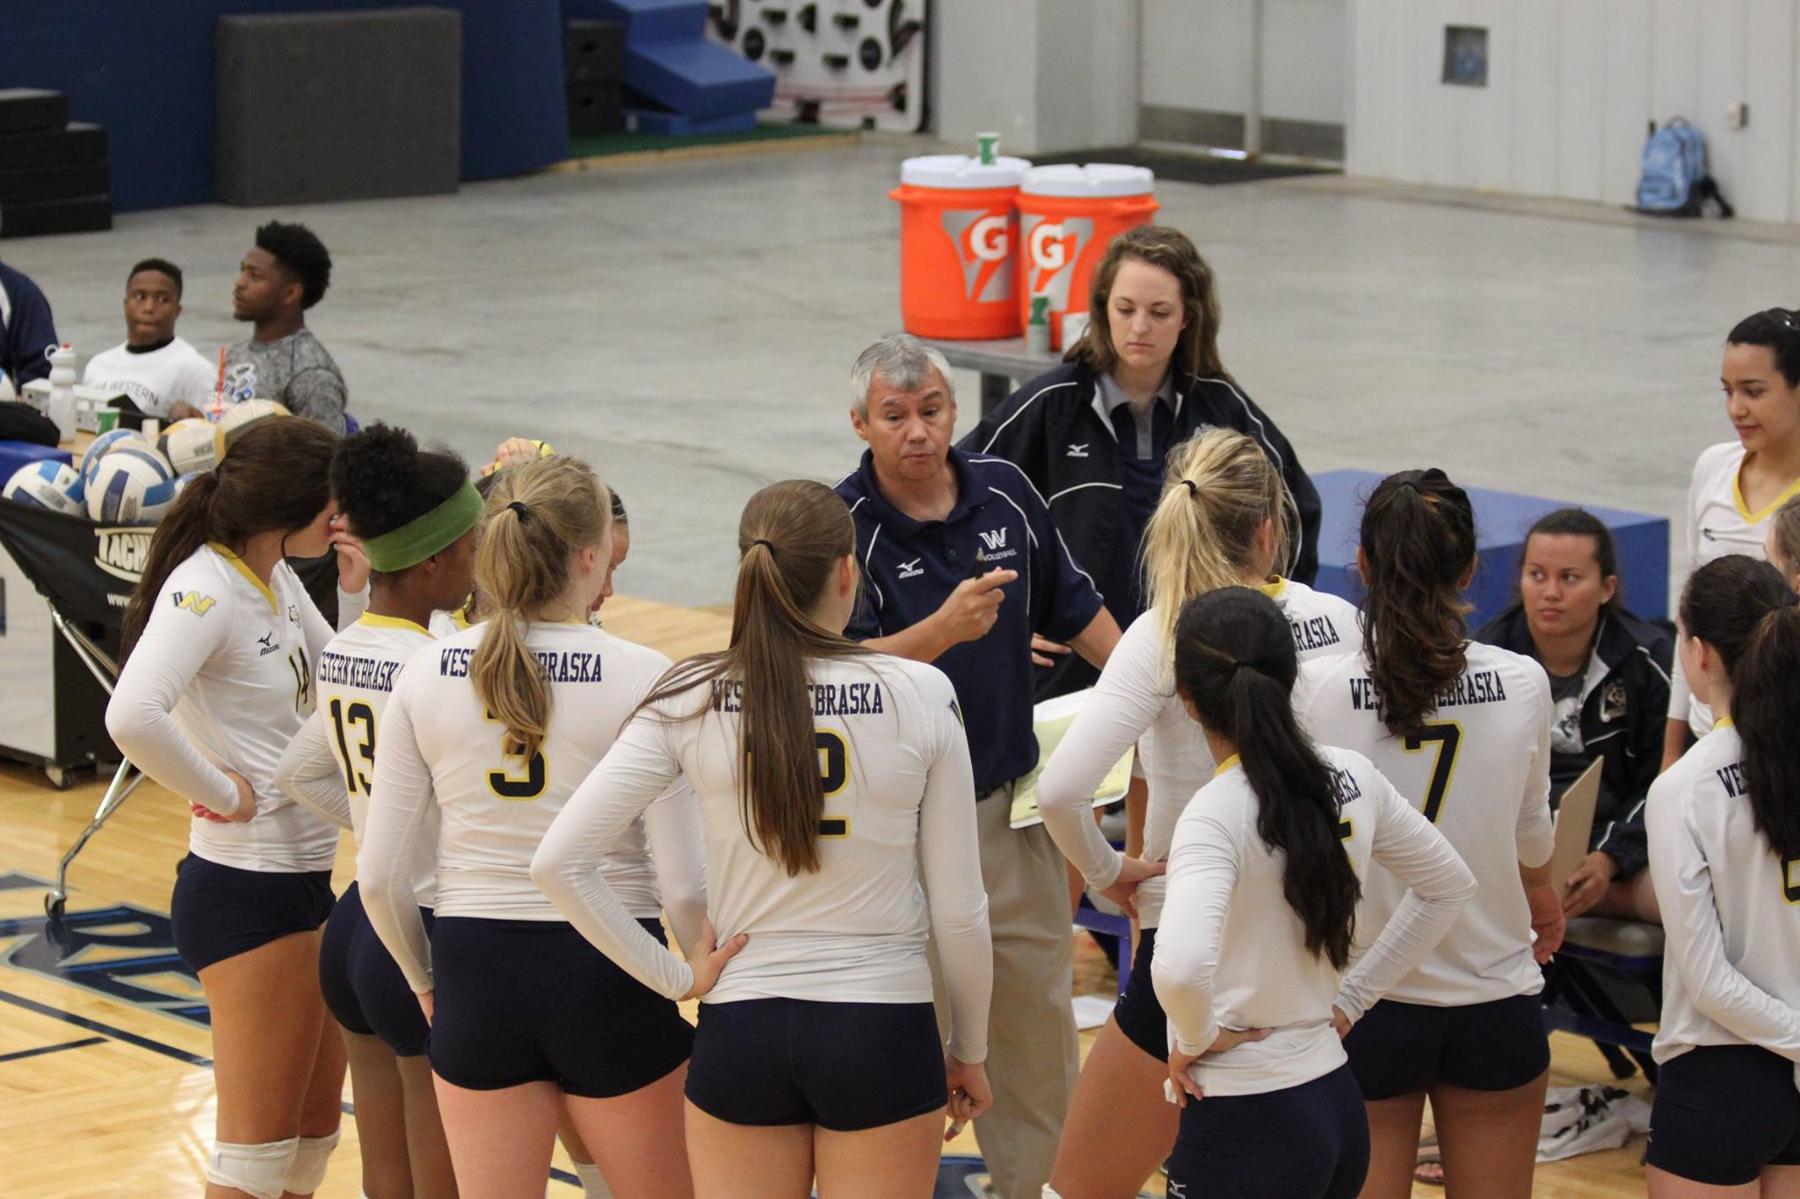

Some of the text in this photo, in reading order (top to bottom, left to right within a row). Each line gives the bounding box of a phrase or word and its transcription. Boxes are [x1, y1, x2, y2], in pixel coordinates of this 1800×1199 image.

[970, 216, 1008, 261] G
[1031, 224, 1065, 269] G
[1291, 614, 1341, 652] RASKA
[349, 655, 404, 693] NEBRASK
[330, 698, 376, 797] 13
[1404, 722, 1461, 824] 7
